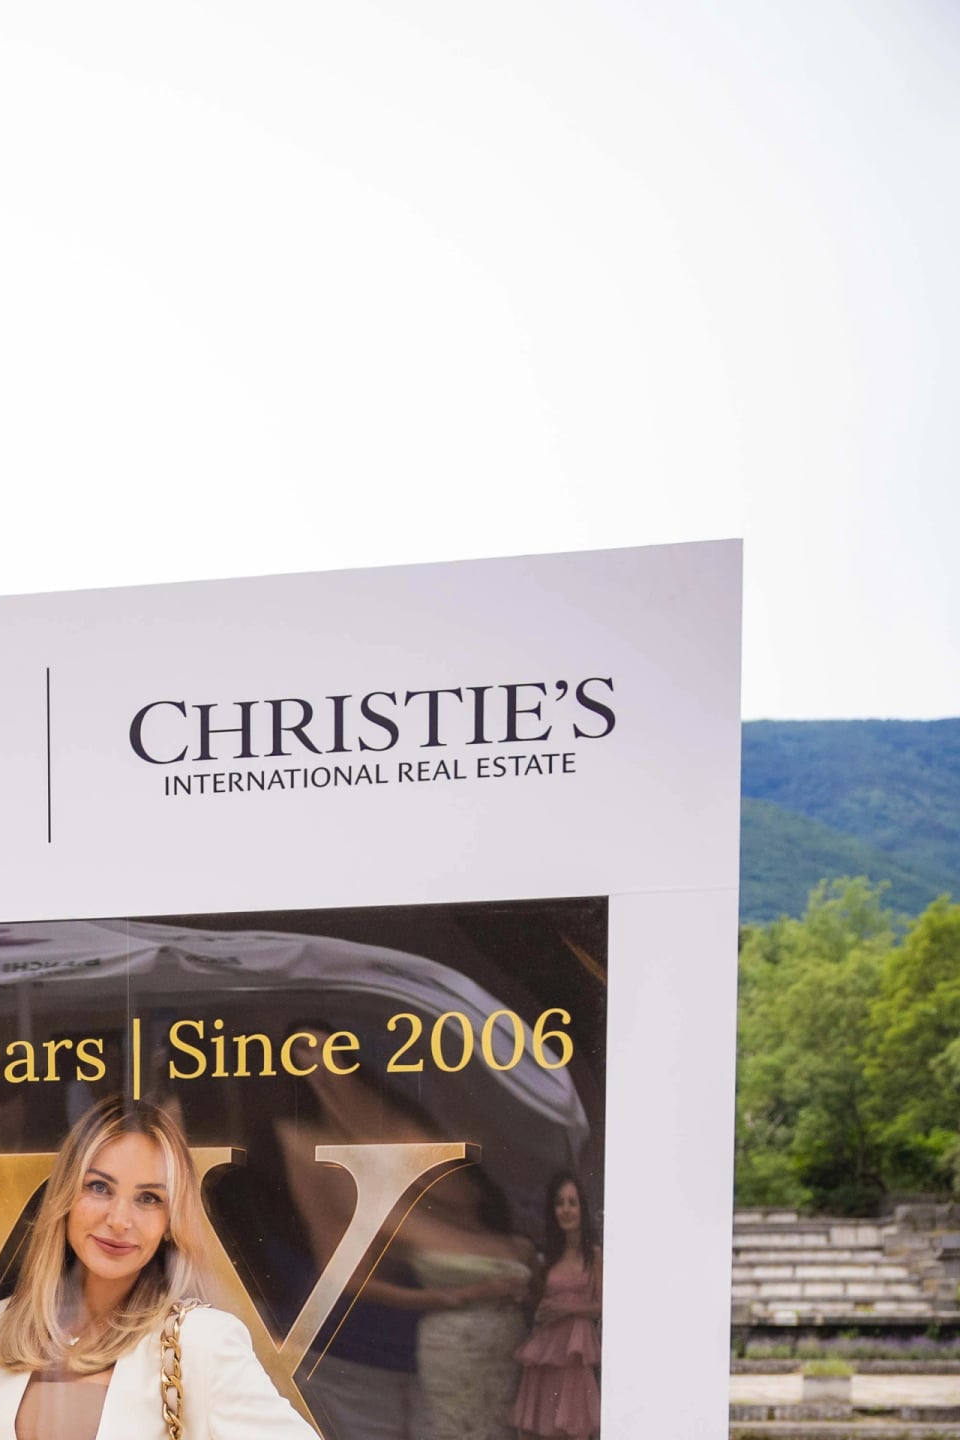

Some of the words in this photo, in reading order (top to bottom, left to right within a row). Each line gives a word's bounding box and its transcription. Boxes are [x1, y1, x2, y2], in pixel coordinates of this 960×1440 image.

[129, 677, 617, 765] CHRISTIE’S
[164, 763, 389, 796] INTERNATIONAL
[398, 759, 467, 783] REAL
[476, 752, 576, 779] ESTATE
[169, 1019, 360, 1080] Since
[387, 1008, 574, 1073] 2006
